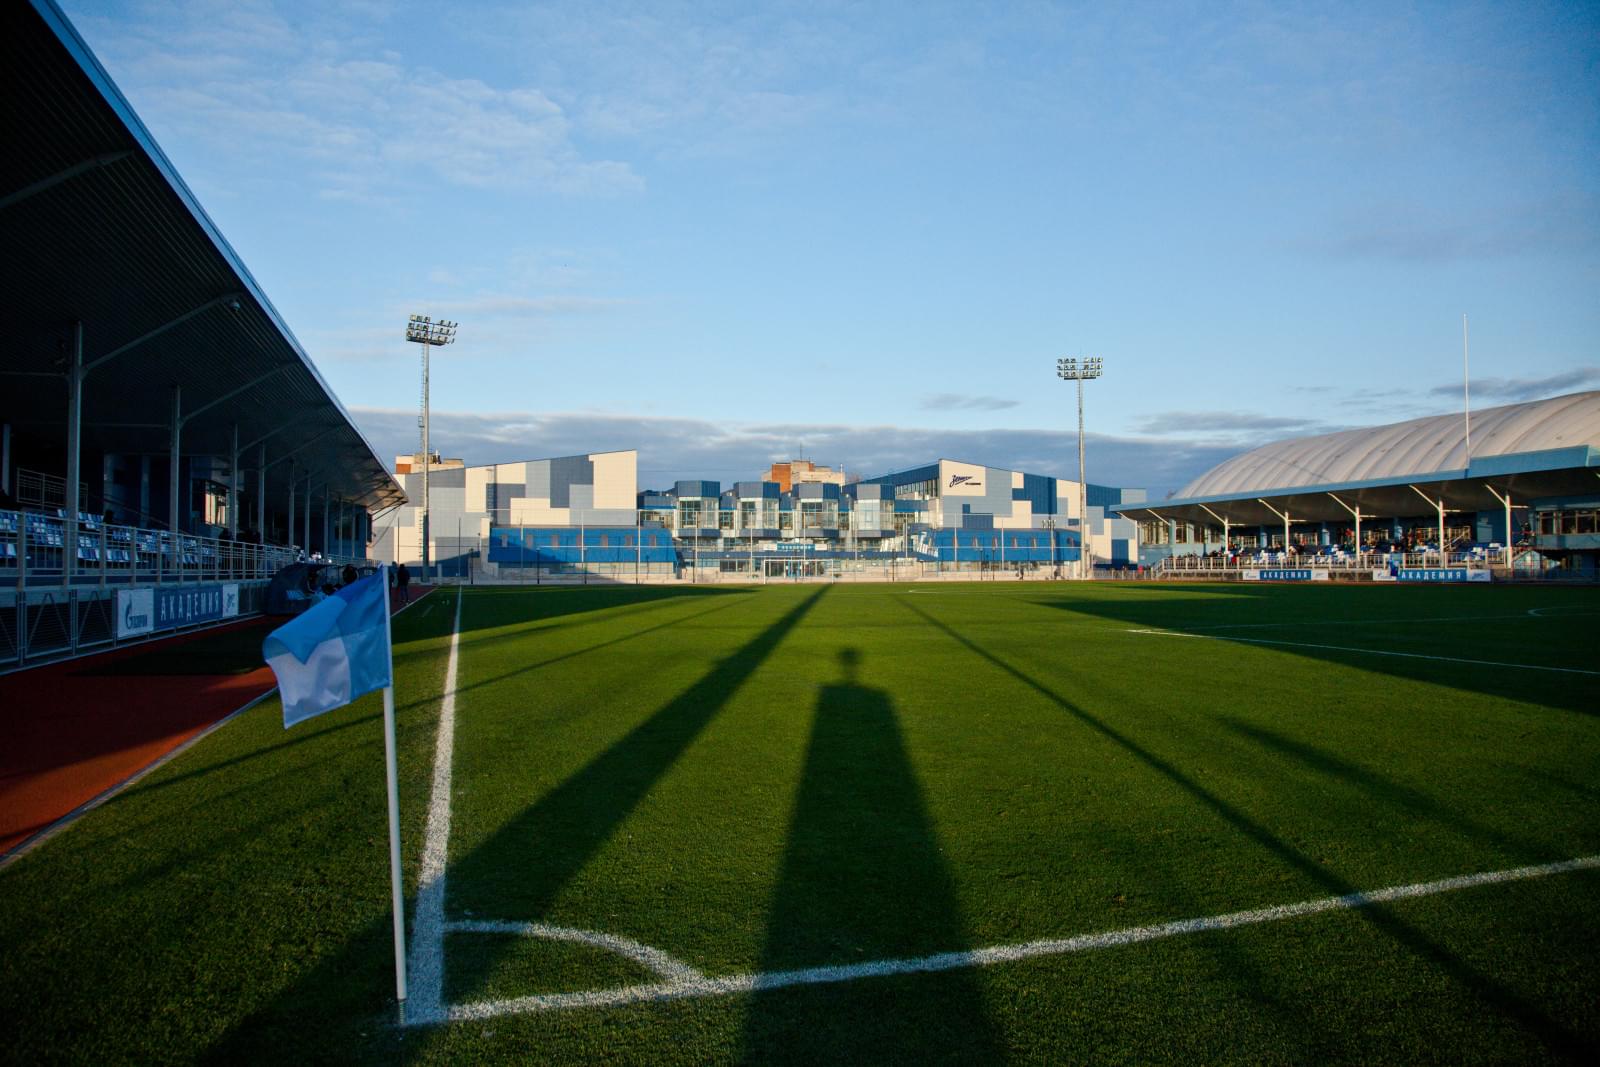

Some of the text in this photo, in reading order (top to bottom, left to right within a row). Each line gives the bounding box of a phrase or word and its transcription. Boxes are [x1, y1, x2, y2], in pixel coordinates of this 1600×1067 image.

[1263, 571, 1308, 580] АКАДЕМИЯ
[1401, 571, 1461, 580] АКАДЕМИЯ
[160, 591, 219, 622] АКАДЕМИЯ
